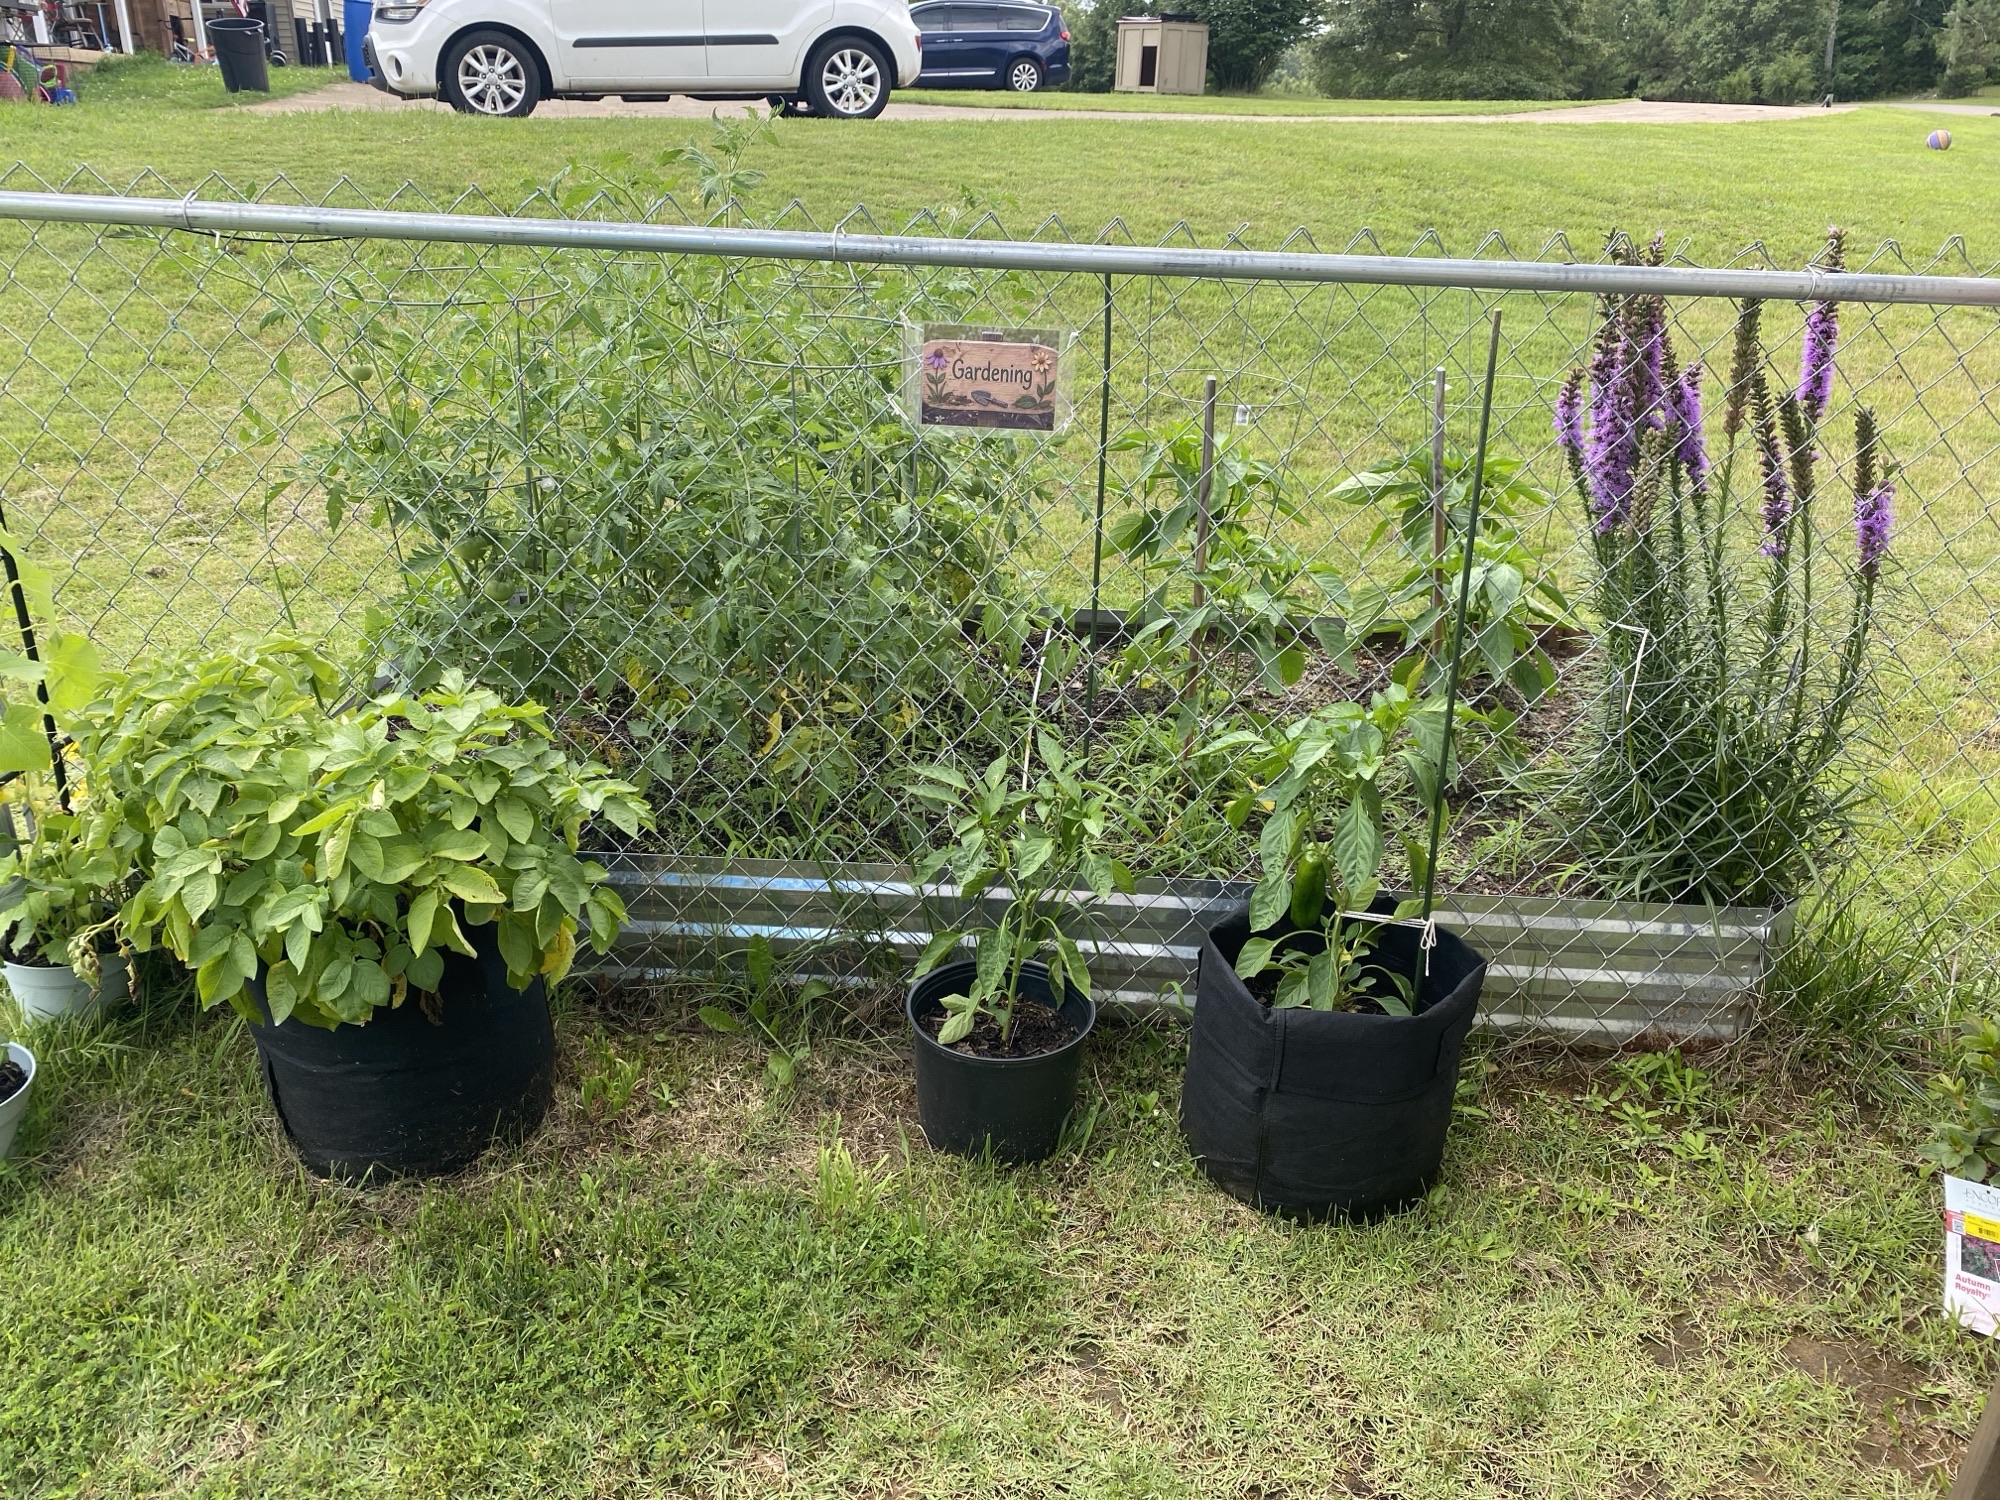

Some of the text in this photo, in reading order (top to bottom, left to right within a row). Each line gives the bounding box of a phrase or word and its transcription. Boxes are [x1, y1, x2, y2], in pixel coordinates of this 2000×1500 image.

[952, 358, 1033, 390] Gardening
[1955, 1273, 1991, 1291] Autumn
[1955, 1282, 1988, 1300] Royalty
